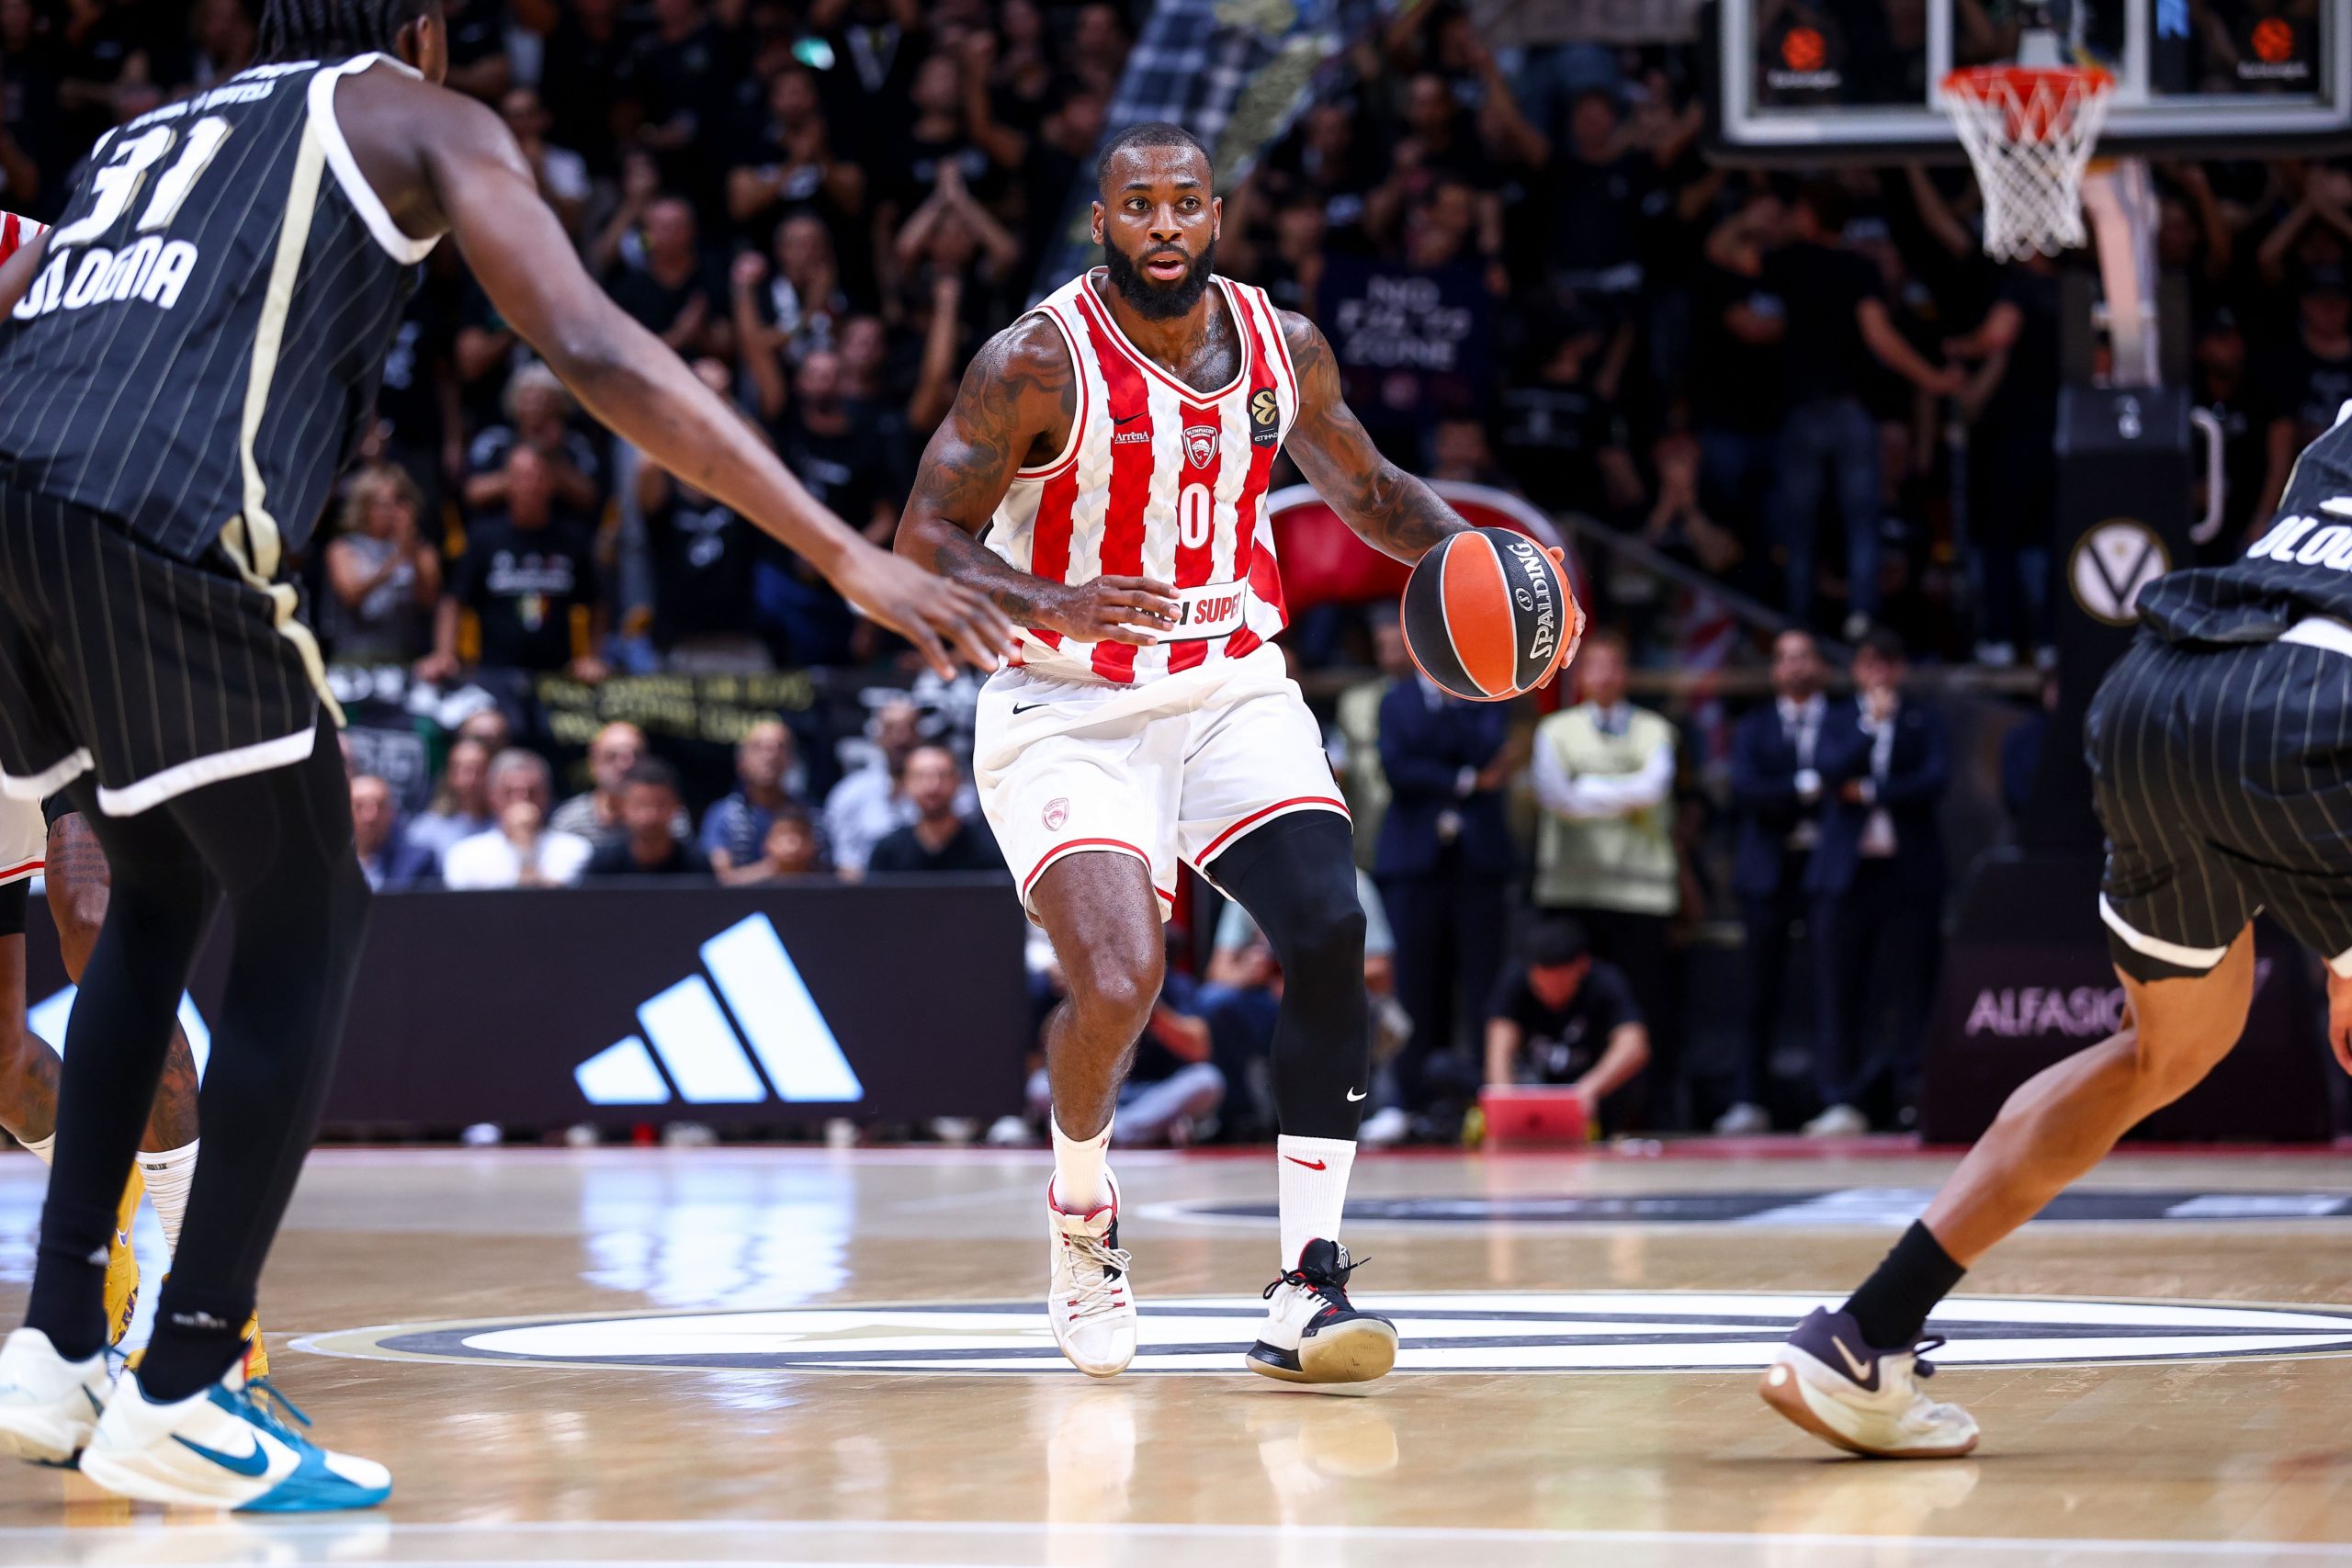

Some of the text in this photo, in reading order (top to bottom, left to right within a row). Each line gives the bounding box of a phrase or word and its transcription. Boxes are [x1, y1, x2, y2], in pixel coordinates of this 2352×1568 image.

[49, 115, 234, 254] 31
[1254, 432, 1278, 442] ETIHAD
[1180, 482, 1210, 549] 0
[1506, 539, 1555, 660] SPALDING
